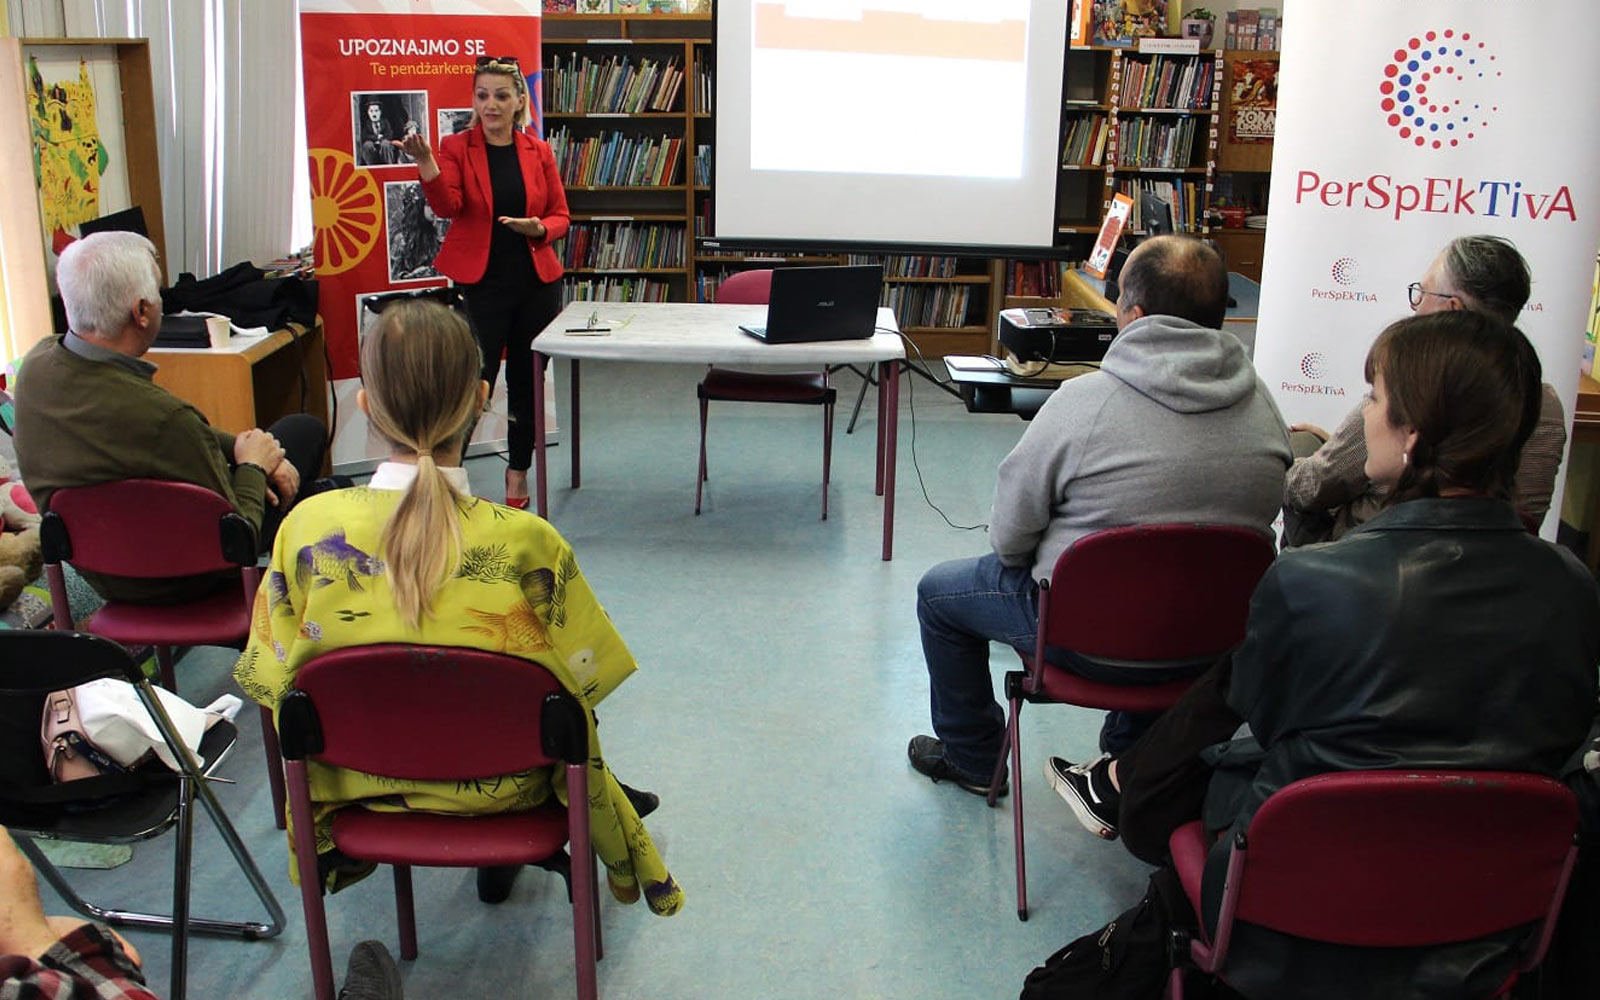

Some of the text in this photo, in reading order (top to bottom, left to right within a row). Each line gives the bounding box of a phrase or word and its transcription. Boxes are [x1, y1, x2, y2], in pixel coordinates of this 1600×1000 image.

[338, 39, 486, 56] UPOZNAJMO SE
[370, 62, 387, 75] Te
[1296, 171, 1577, 221] PerSpEkTivA
